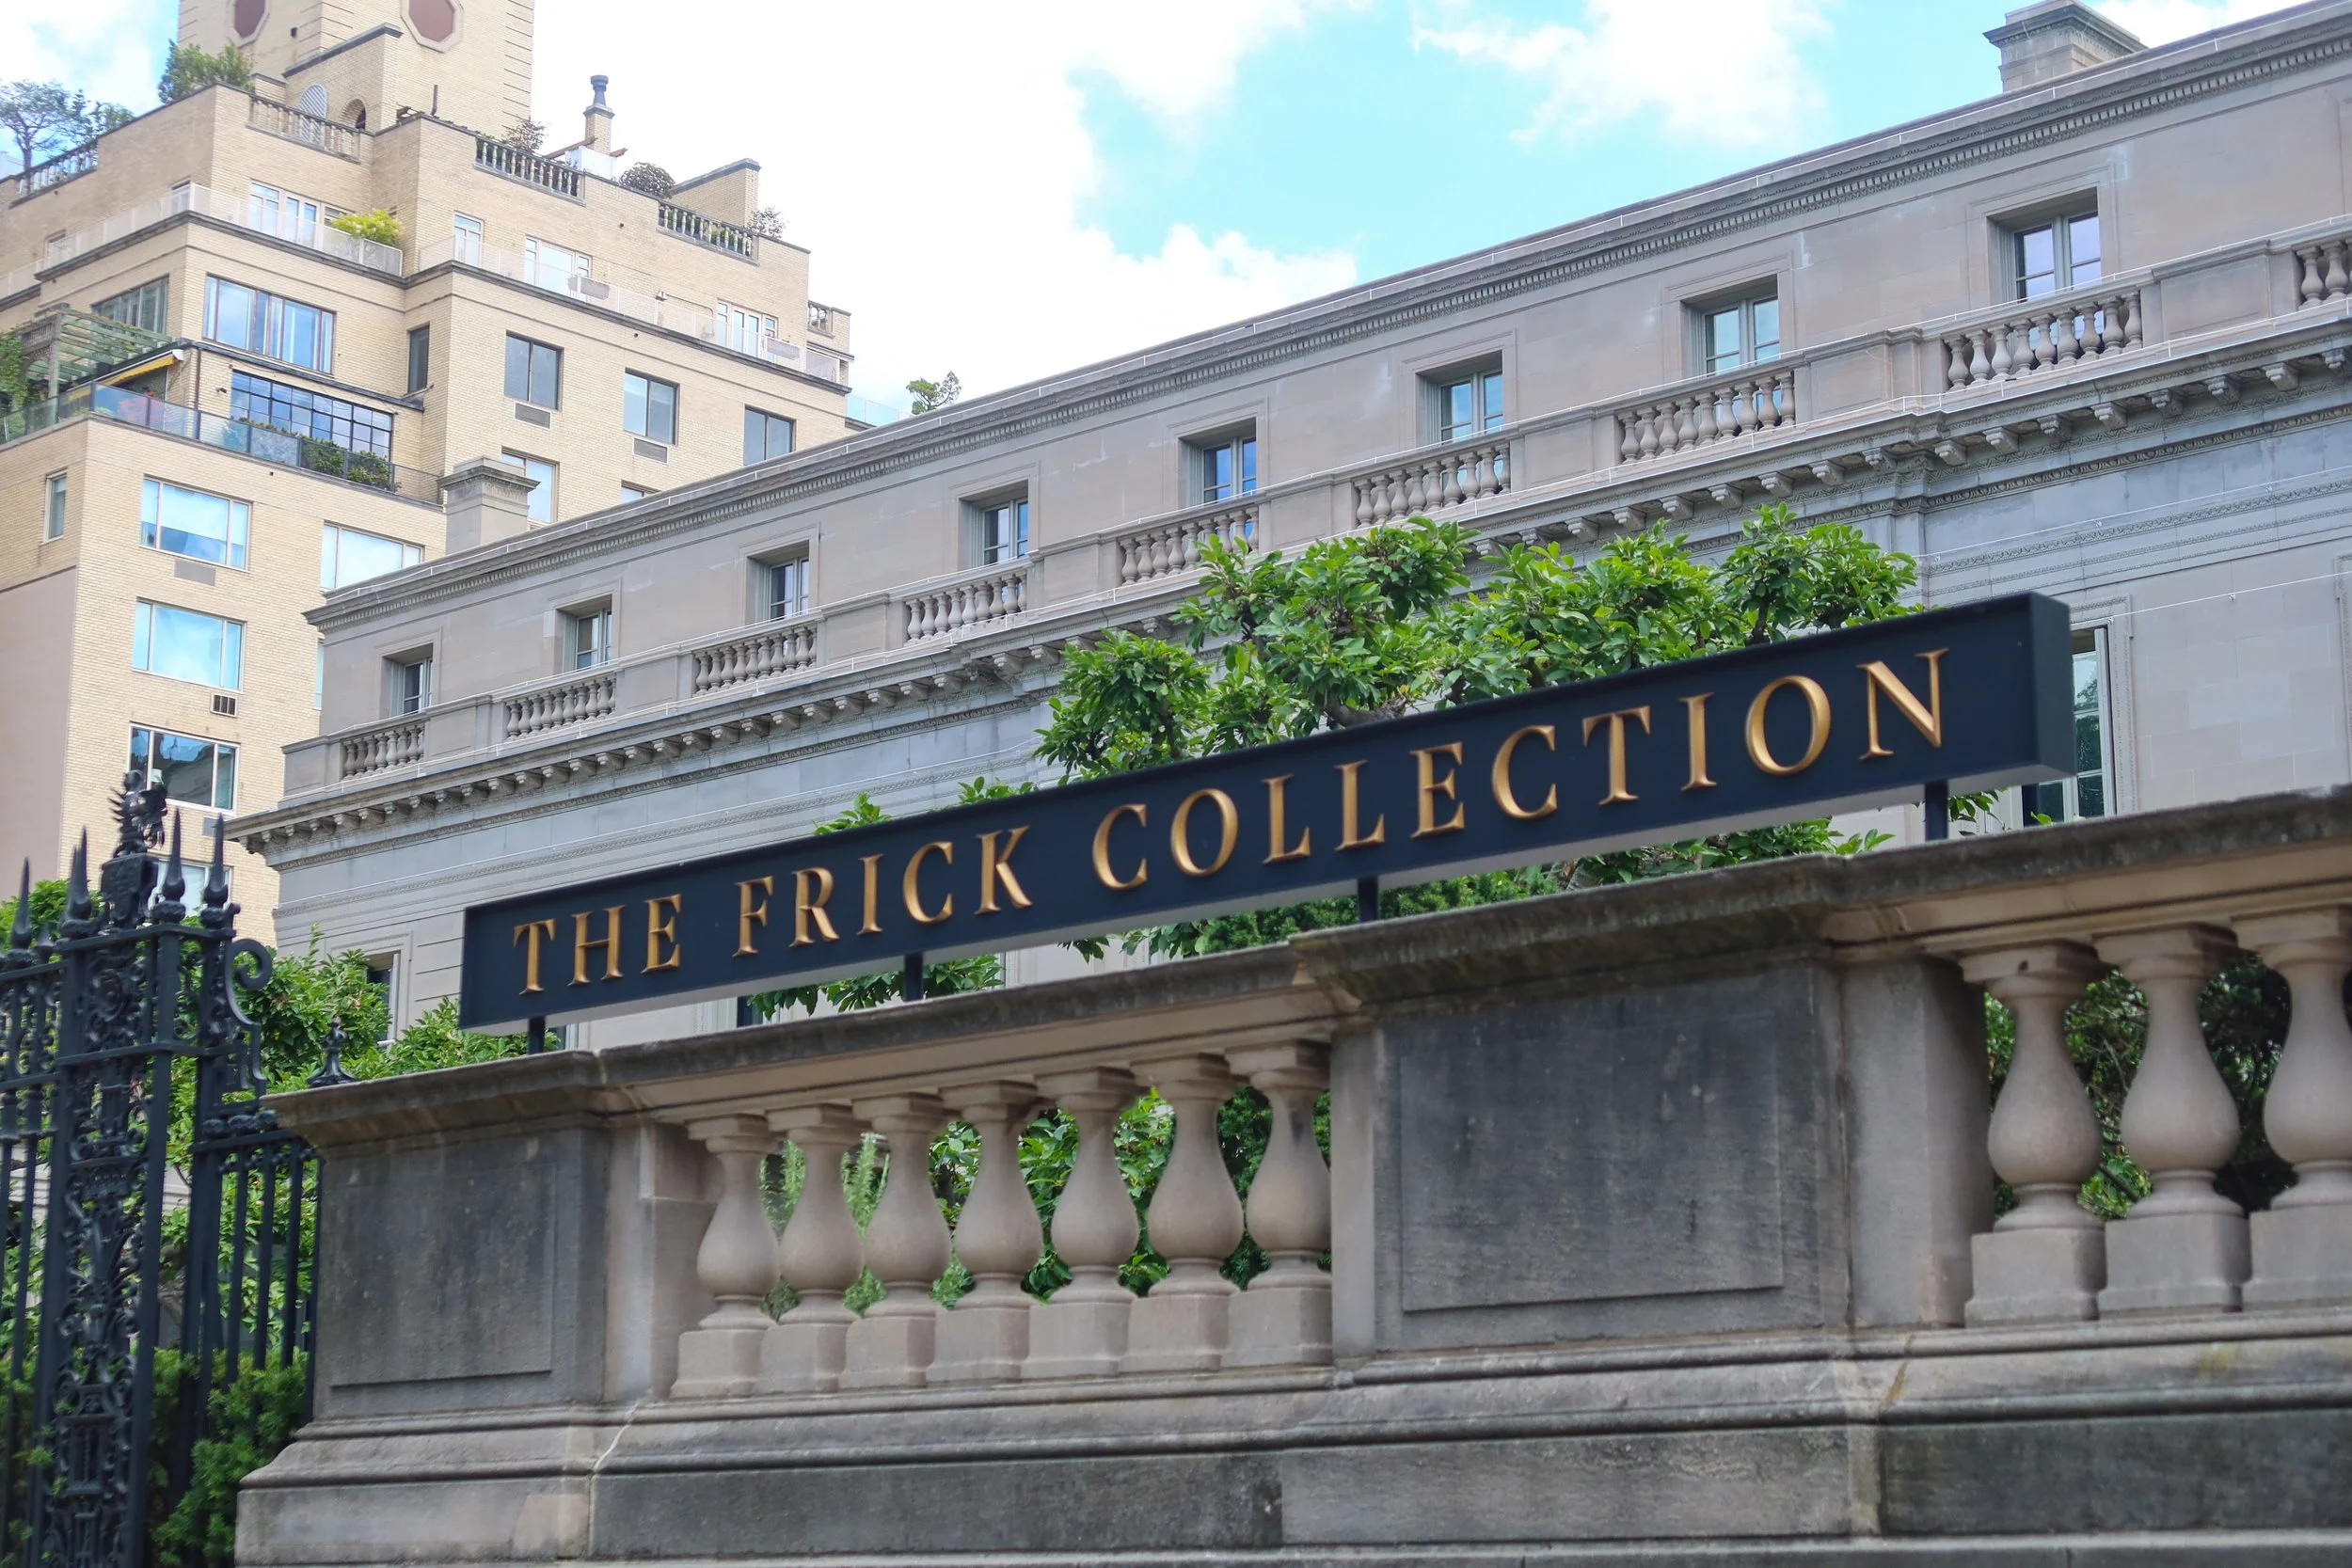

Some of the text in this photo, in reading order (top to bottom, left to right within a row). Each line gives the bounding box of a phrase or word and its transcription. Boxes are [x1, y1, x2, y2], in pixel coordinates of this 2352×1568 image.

[513, 647, 1950, 995] THE FRICK COLLECTION
